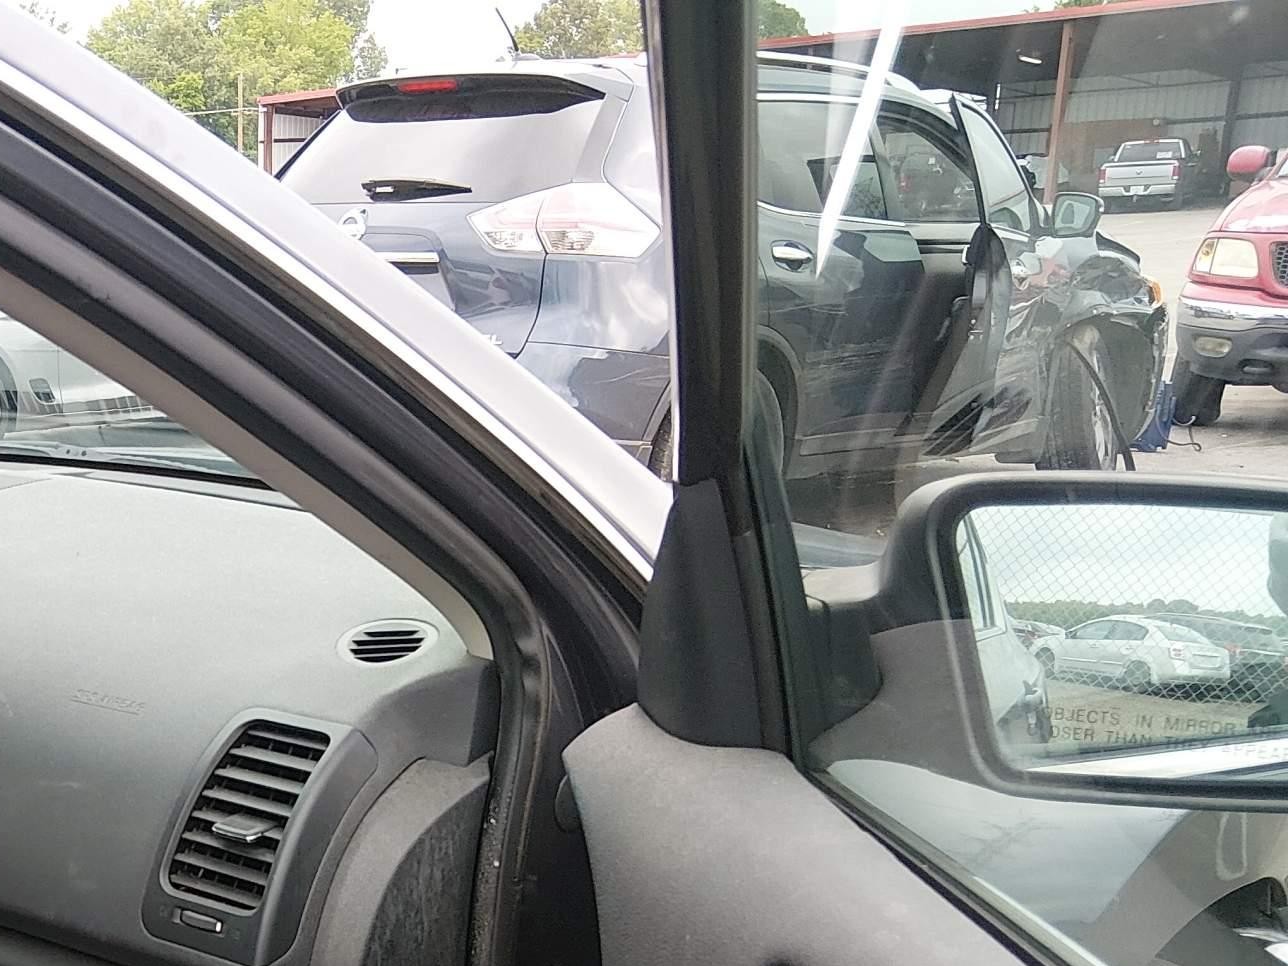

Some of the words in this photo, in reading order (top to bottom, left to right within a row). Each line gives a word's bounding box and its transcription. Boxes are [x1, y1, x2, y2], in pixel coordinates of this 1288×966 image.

[1027, 723, 1095, 742] COSER
[1104, 730, 1152, 746] THAN
[1135, 714, 1152, 729] IN
[1163, 716, 1236, 738] MIRROR
